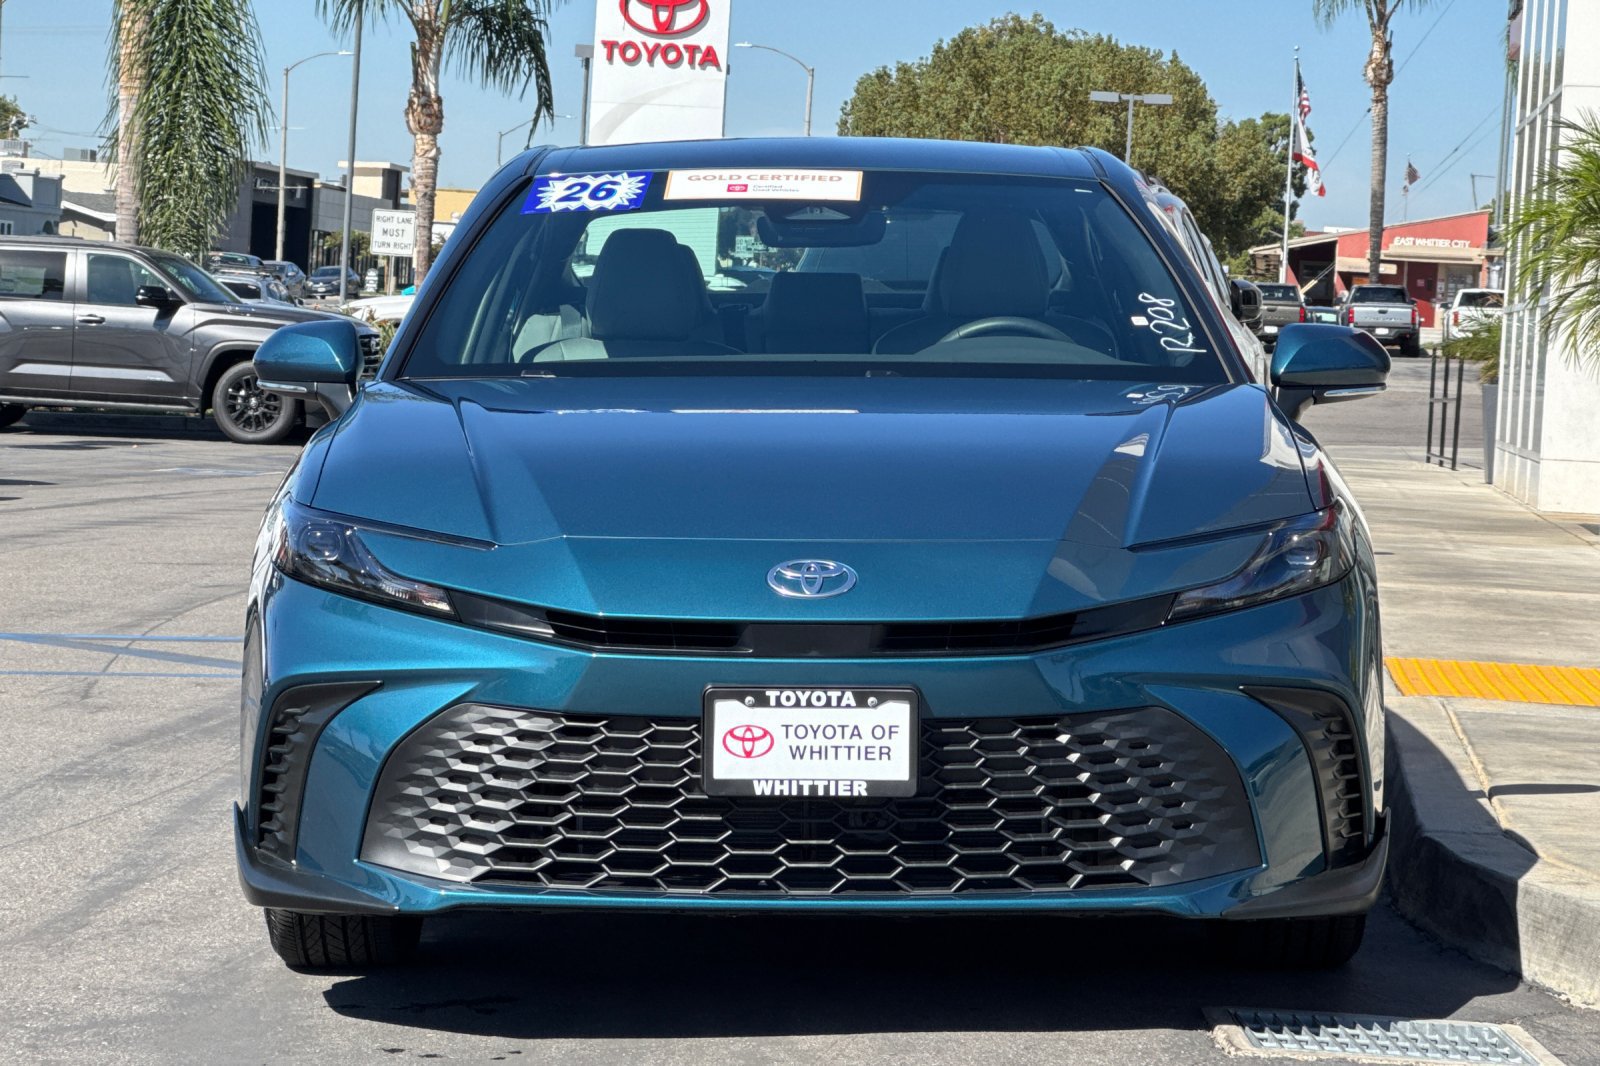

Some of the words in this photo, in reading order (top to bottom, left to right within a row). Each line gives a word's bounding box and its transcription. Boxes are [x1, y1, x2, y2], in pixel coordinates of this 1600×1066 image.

[601, 40, 721, 69] TOYOTA
[687, 174, 742, 182] GOLD
[747, 174, 843, 182] CERTIFIED
[555, 180, 622, 203] 26
[376, 215, 395, 223] RIGHT
[397, 216, 413, 225] LANE
[382, 227, 405, 238] MUST
[374, 240, 391, 249] TURN
[393, 241, 412, 250] RIGHT
[1394, 237, 1414, 246] EAST
[1415, 237, 1451, 248] WHITTIER
[1452, 239, 1470, 248] CITY
[765, 691, 856, 707] TOYOTA
[781, 724, 863, 740] TOYOTA
[871, 724, 900, 740] OF
[789, 745, 892, 761] WHITTIER
[753, 779, 868, 796] WHITTIER
